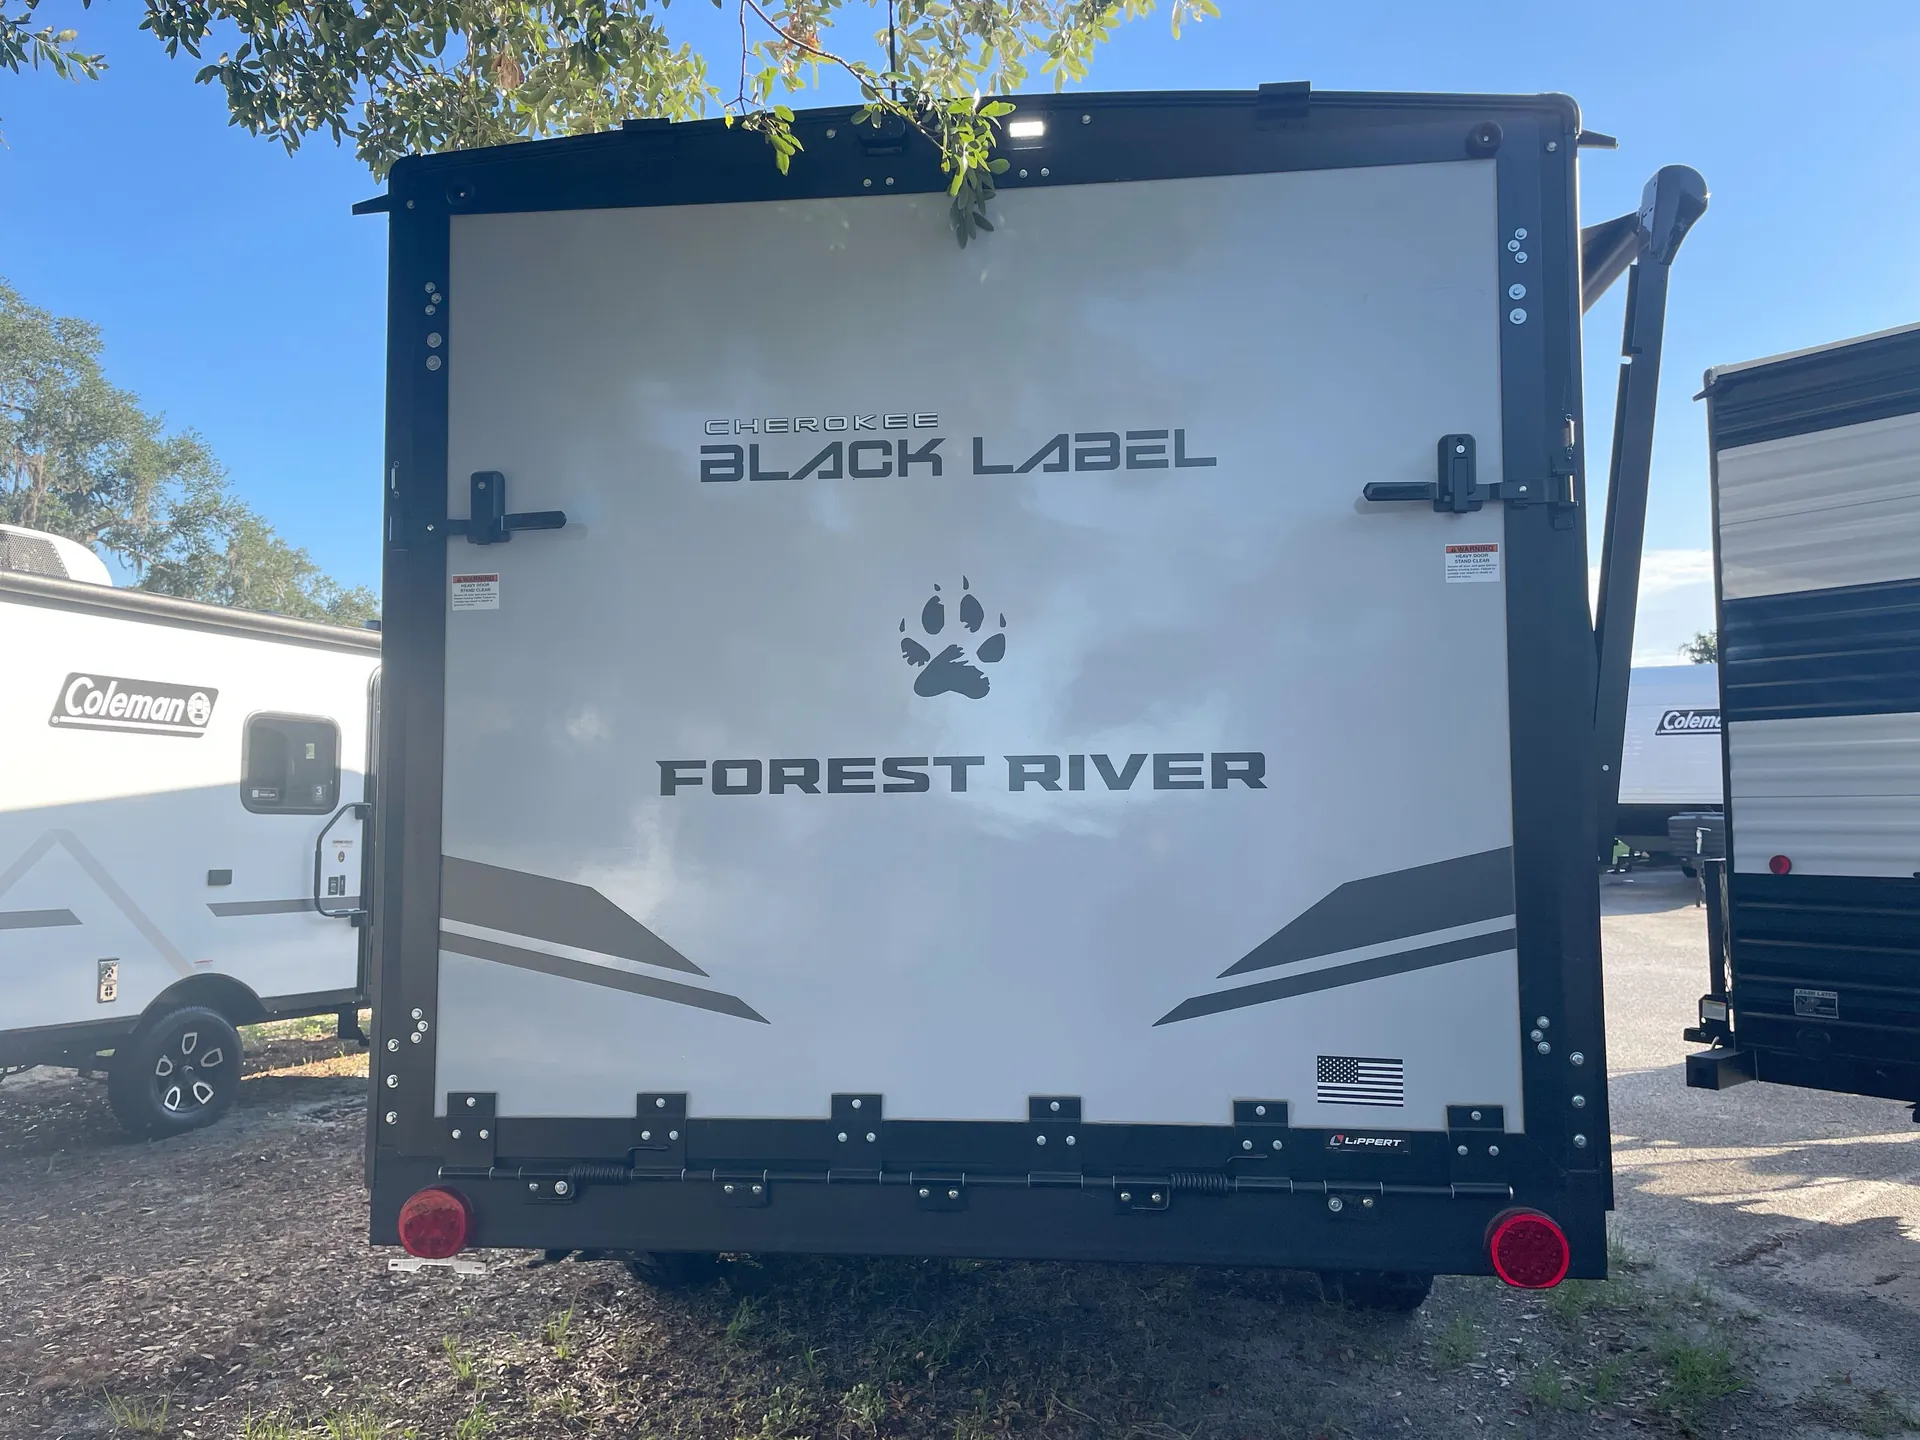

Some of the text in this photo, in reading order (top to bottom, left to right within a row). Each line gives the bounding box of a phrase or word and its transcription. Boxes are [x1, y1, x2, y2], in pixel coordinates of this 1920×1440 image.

[704, 412, 939, 435] CHEROKEE
[700, 428, 1217, 482] BLACK LABEL
[1457, 544, 1494, 553] WARNING
[64, 676, 186, 723] Coleman
[655, 752, 1268, 796] FOREST RIVER
